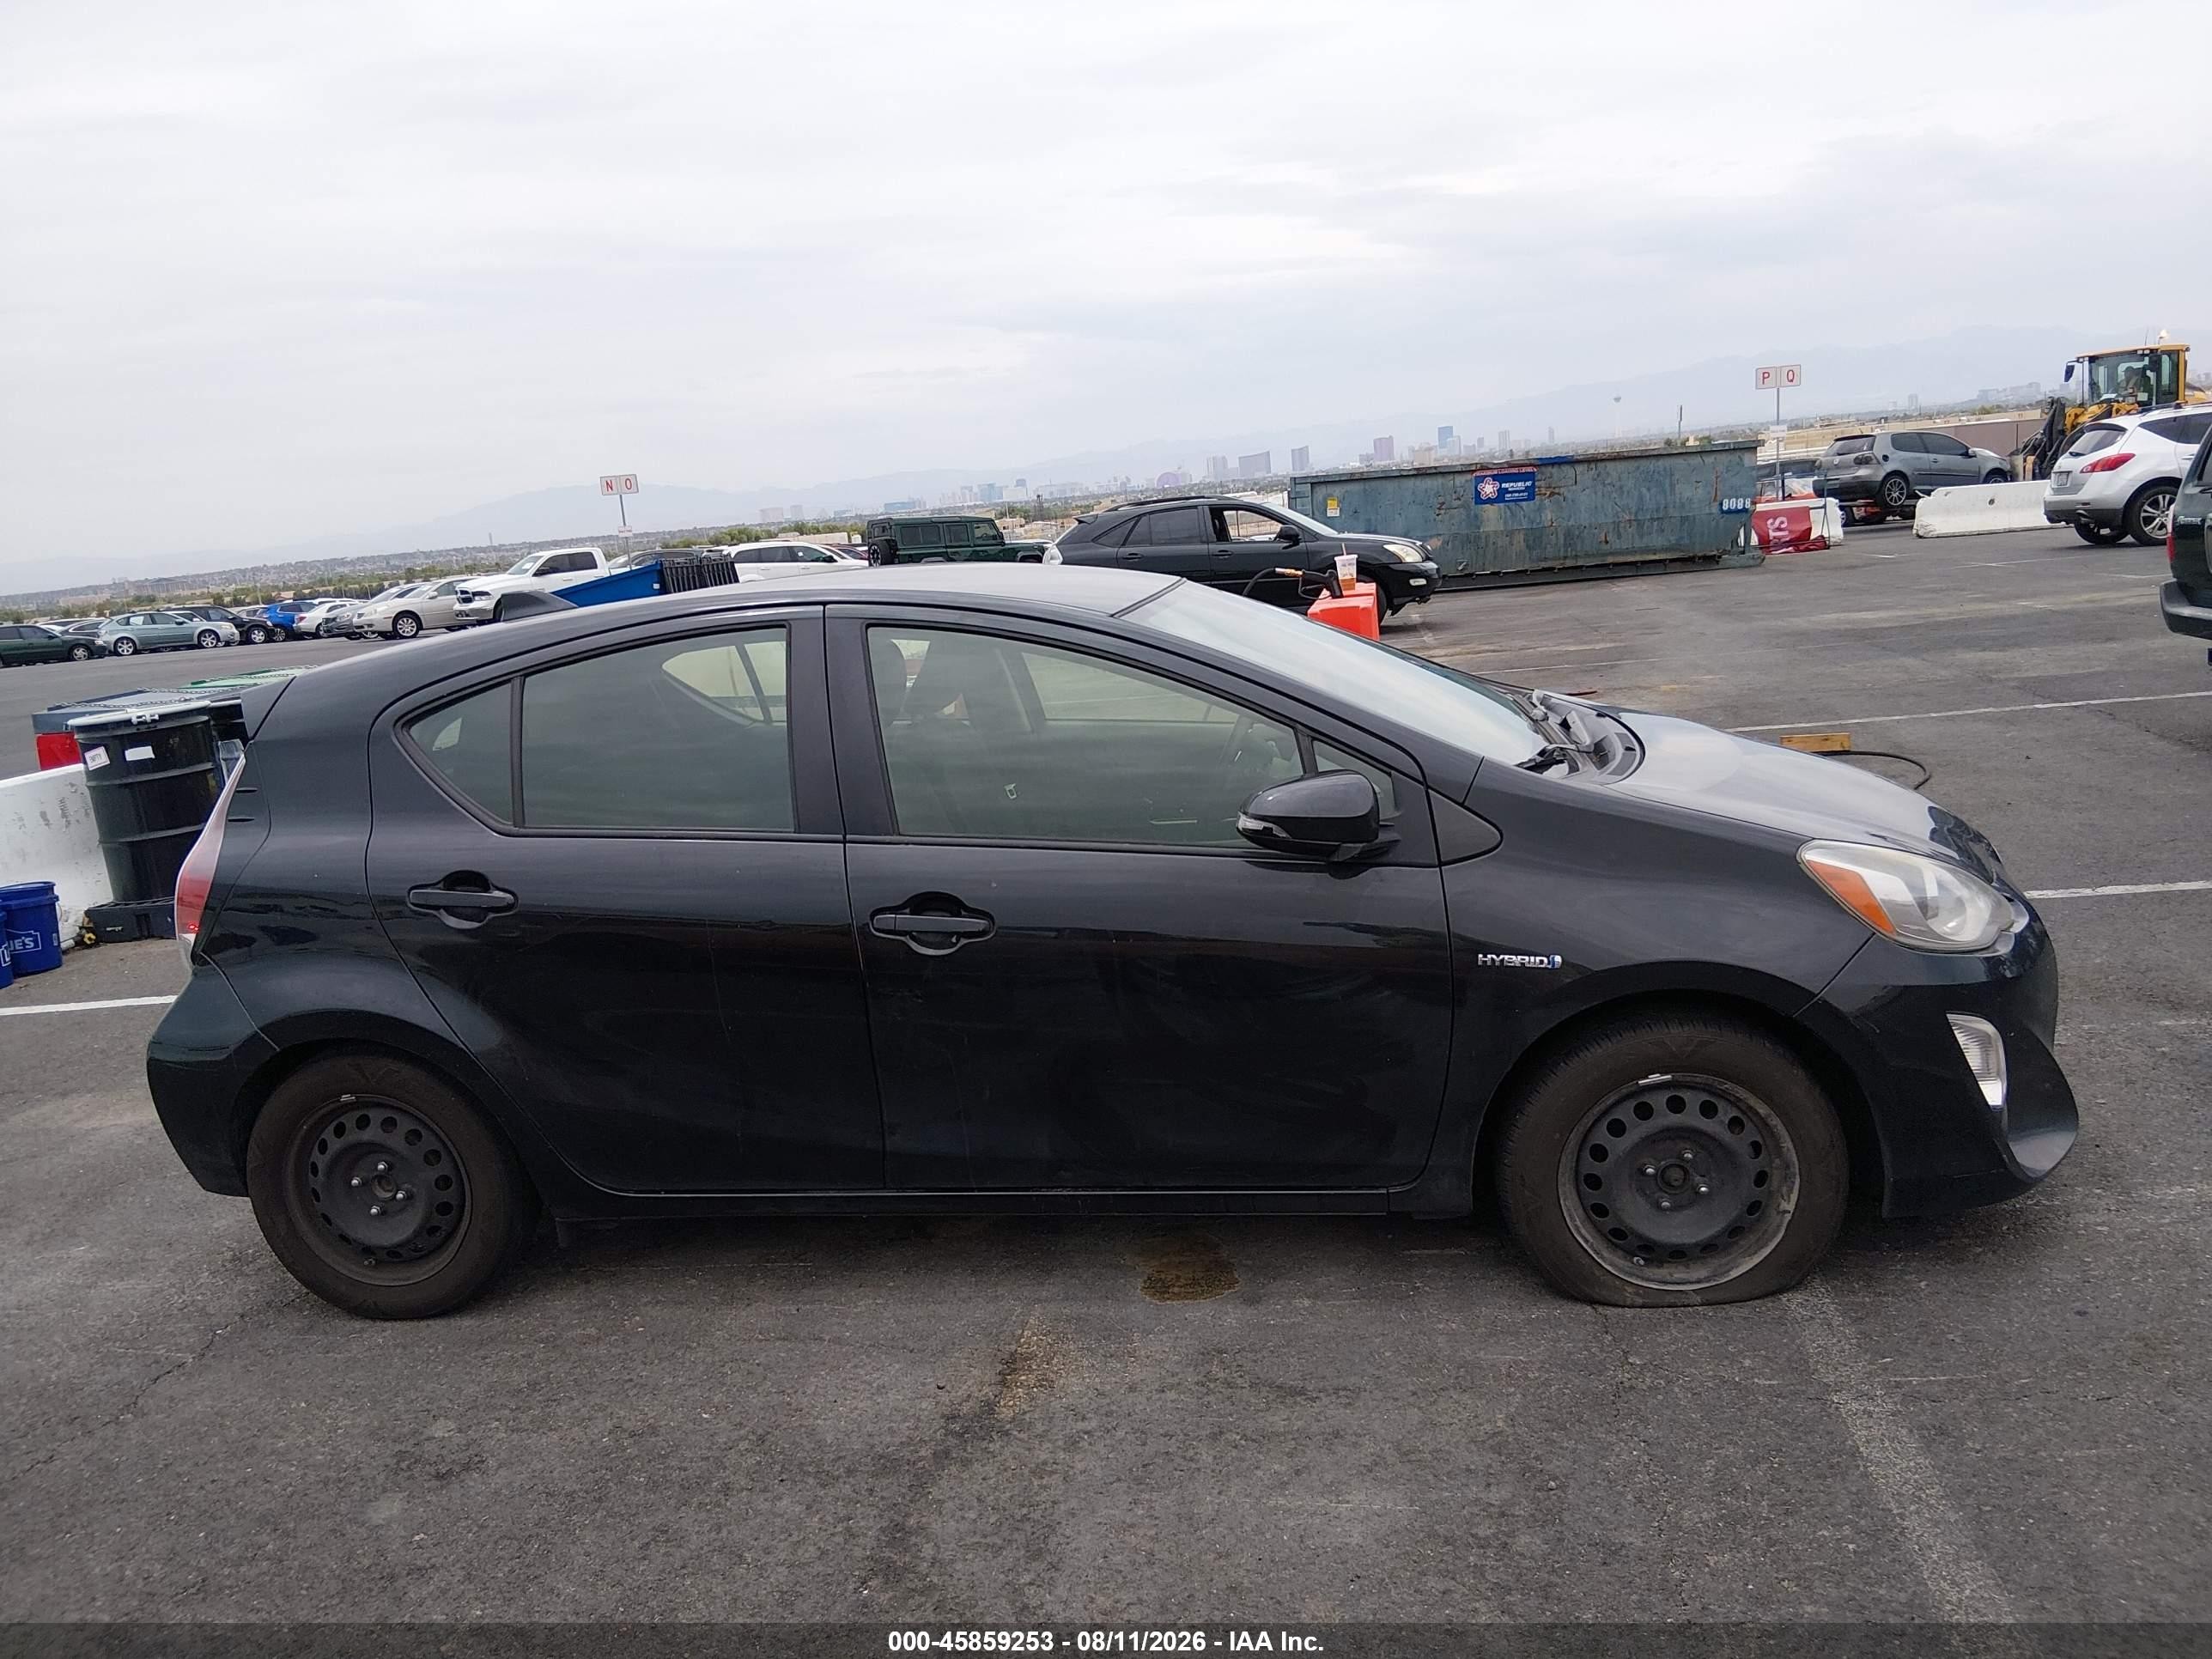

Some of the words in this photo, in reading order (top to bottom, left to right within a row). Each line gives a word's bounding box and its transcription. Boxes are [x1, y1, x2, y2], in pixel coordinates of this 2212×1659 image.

[1762, 371, 1771, 386] P
[1786, 369, 1796, 383] Q
[605, 479, 613, 492] N
[1722, 497, 1751, 510] 8088
[1478, 953, 1549, 969] HYBRID
